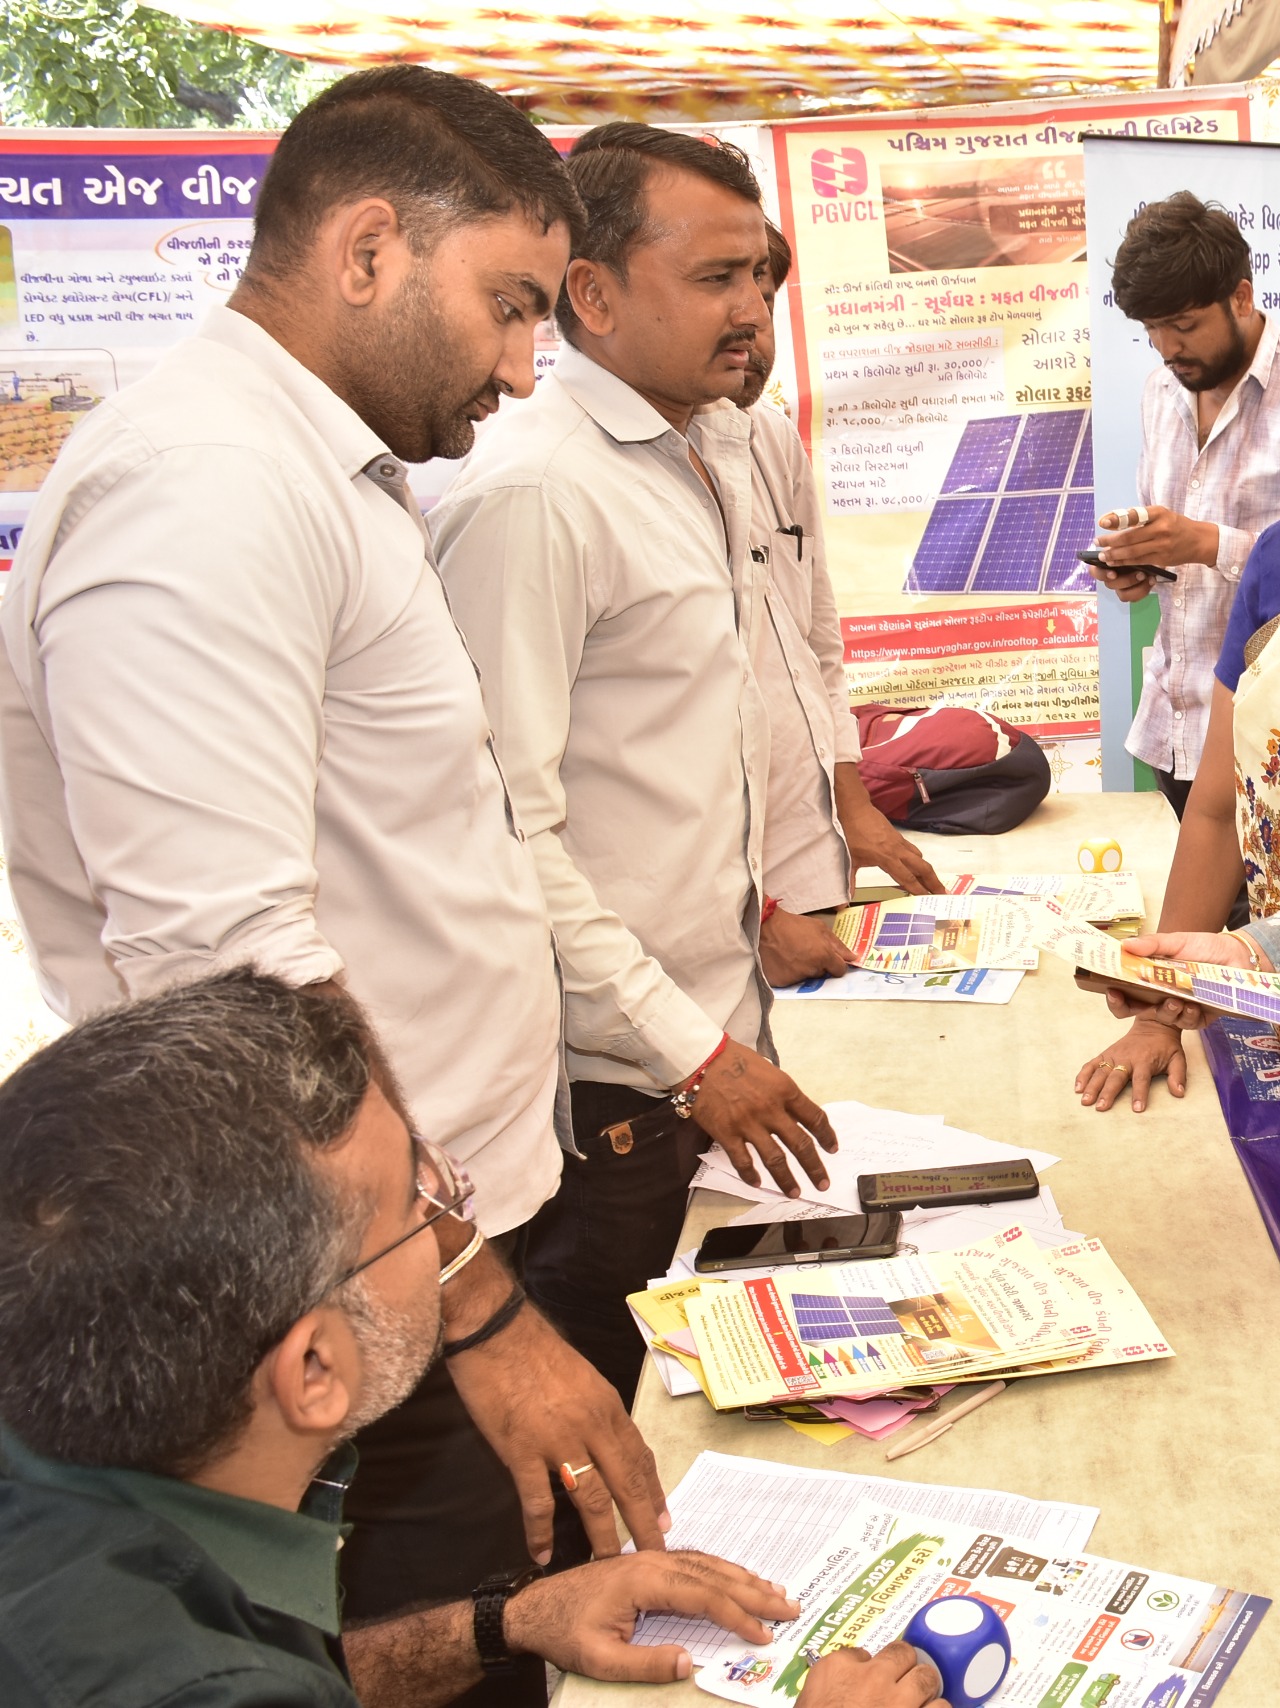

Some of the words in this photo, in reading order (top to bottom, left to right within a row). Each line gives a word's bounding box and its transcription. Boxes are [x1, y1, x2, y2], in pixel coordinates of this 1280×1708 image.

[888, 131, 947, 152] પશ્ચિમ
[955, 132, 1028, 155] ગુજરાત
[1035, 125, 1076, 145] વીજ
[1146, 115, 1219, 137] લિમિટેડ
[84, 165, 163, 205] એજ
[181, 165, 257, 205] વીજ
[811, 200, 878, 224] PGVCL
[167, 236, 221, 250] વીજળીની
[217, 252, 241, 265] વીજ
[826, 294, 905, 317] પ્રધાનમંત્રી
[924, 289, 974, 314] સૂર્યઘર
[991, 290, 1024, 305] મફત
[1029, 282, 1079, 302] વીજળી
[25, 313, 45, 323] LED
[949, 314, 974, 325] સોલાર
[1021, 327, 1066, 346] સોલાર
[1015, 384, 1062, 402] સોલાર
[830, 461, 861, 472] સોલાર
[850, 623, 876, 632] આપના
[866, 1558, 896, 1588] 2026
